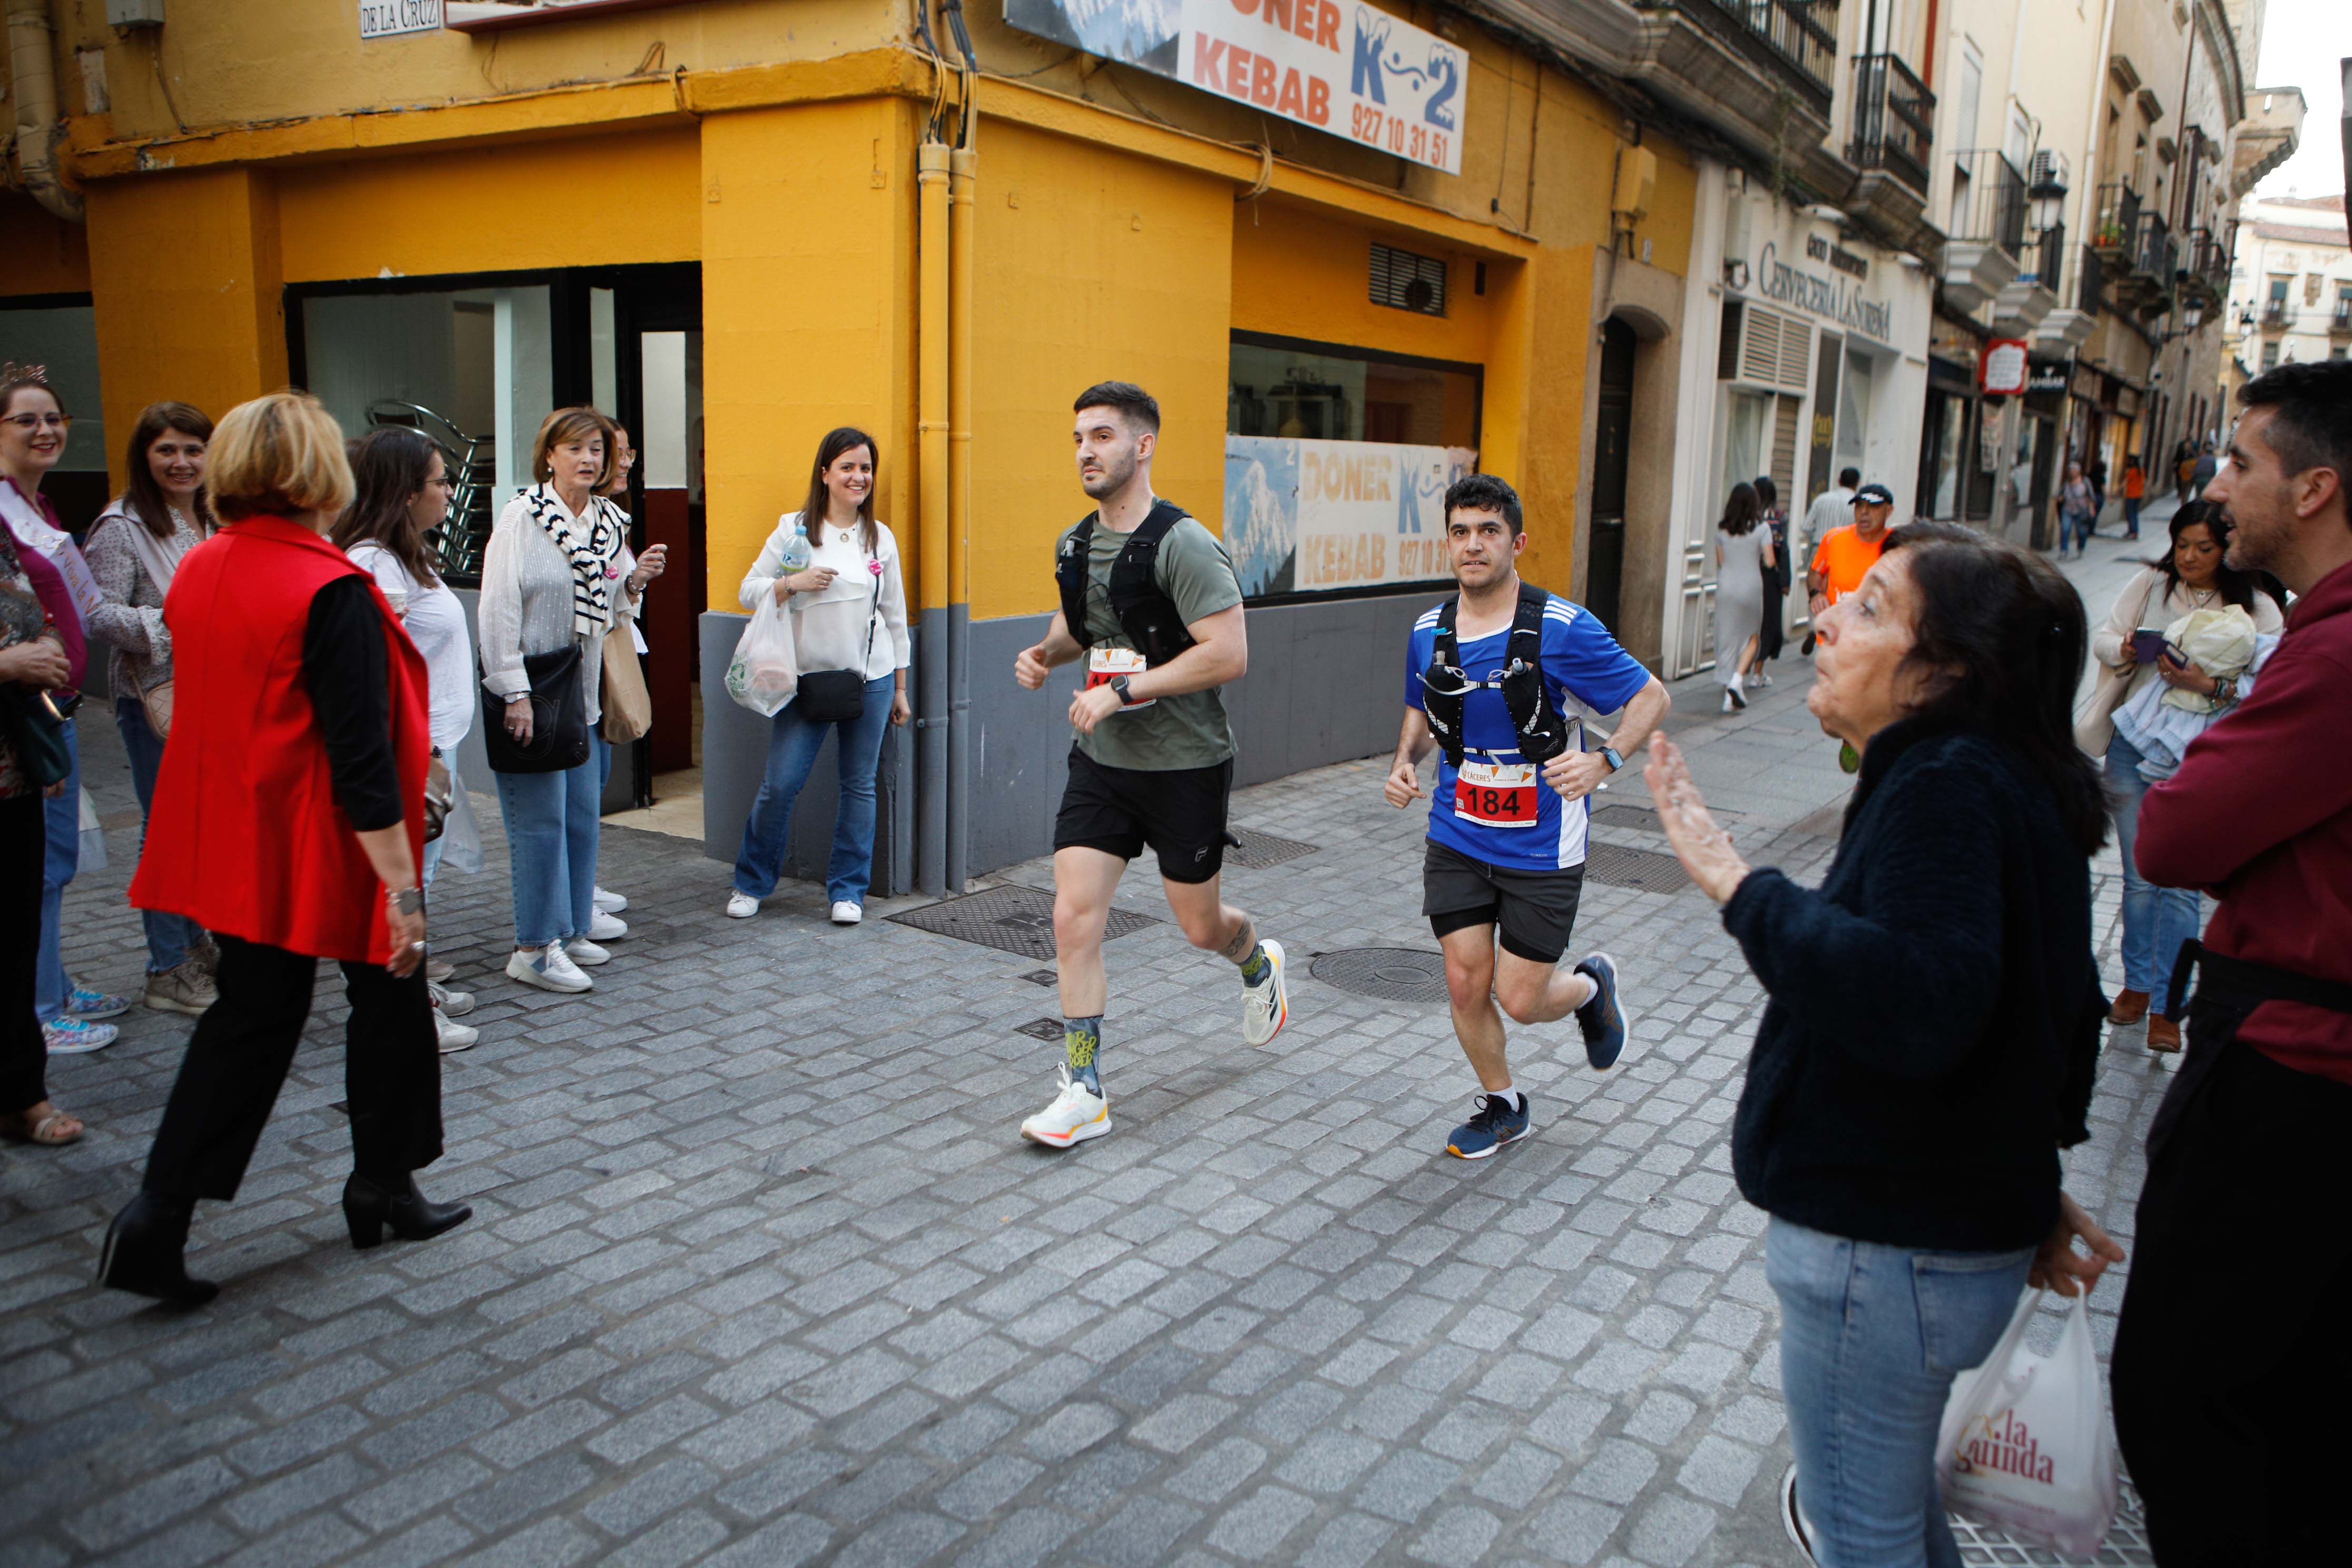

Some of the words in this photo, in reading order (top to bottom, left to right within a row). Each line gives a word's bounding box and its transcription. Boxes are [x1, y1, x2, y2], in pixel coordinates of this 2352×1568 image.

[362, 7, 377, 33] DE
[380, 4, 396, 31] LA
[400, 0, 436, 27] CRUZ
[1193, 31, 1330, 126] KEBAB
[1351, 102, 1383, 145] 927
[1388, 115, 1404, 153] 10
[1409, 123, 1427, 161] 31
[1431, 133, 1448, 169] 51
[1302, 451, 1393, 502] DONER
[1303, 533, 1387, 584] KEBAB
[1399, 540, 1419, 576] 927
[1422, 538, 1433, 574] 10
[1467, 770, 1491, 783] CÁCERES
[1467, 787, 1521, 816] 184
[2004, 1409, 2027, 1449] la
[1955, 1432, 2055, 1485] guinda
